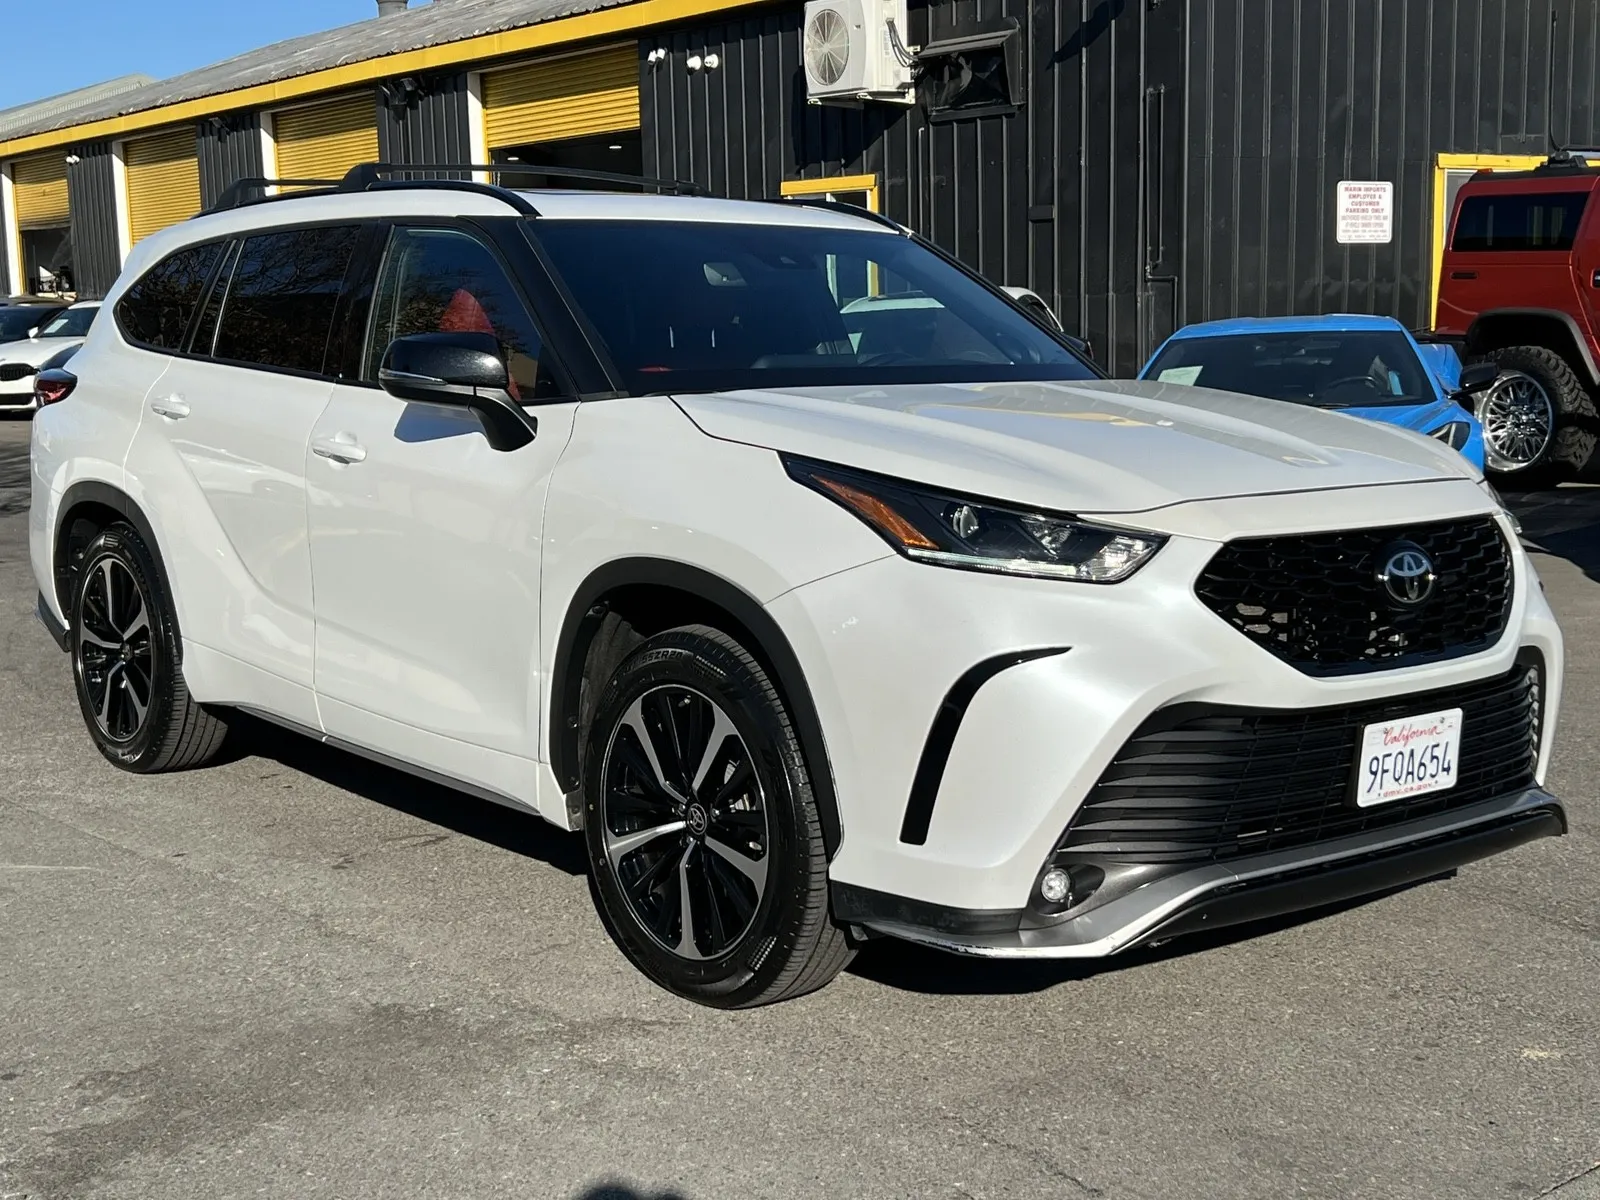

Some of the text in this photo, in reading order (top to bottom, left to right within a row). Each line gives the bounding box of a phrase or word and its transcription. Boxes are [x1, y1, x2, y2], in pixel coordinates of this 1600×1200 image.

[1383, 724, 1444, 747] California
[1366, 741, 1451, 793] 9FQA654
[1383, 783, 1433, 797] dmv.ca.gov
